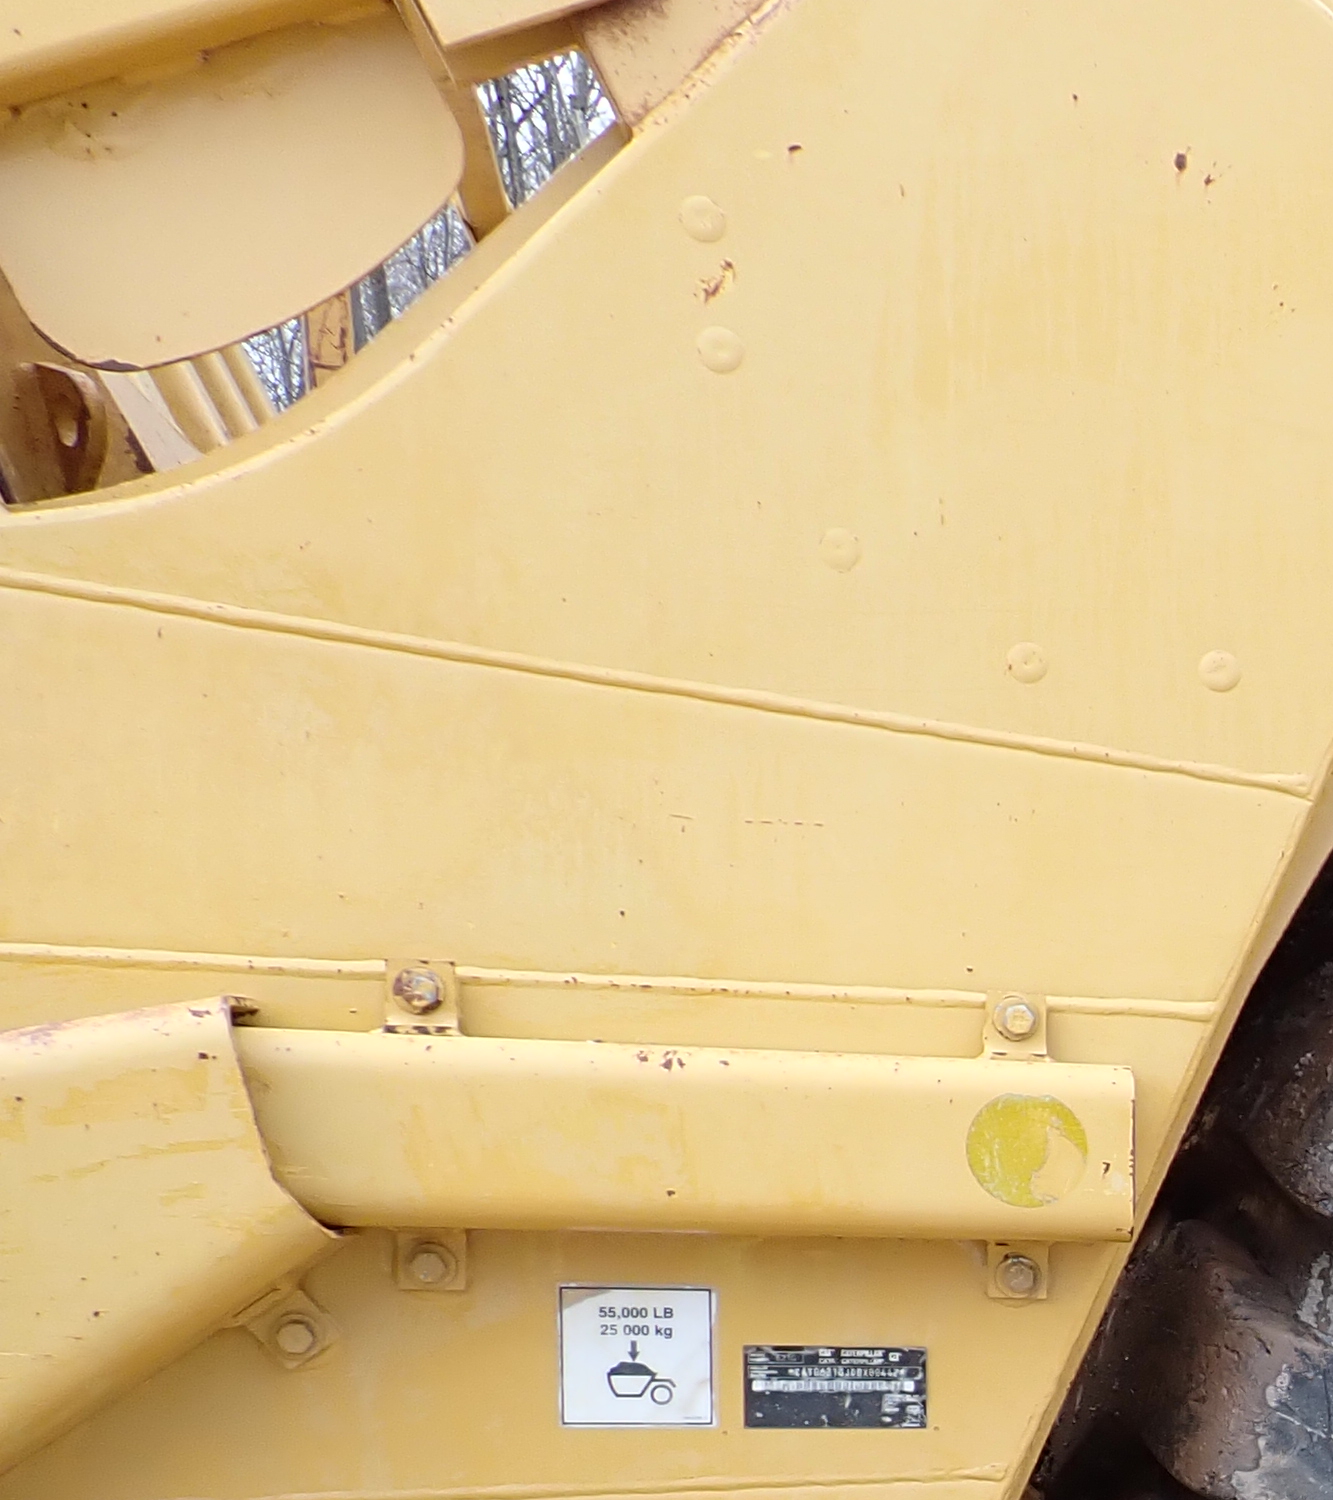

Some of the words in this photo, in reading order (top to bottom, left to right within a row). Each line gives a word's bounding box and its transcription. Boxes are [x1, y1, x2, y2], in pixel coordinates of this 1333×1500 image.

[599, 1307, 648, 1320] 55,000
[654, 1307, 674, 1319] LB
[600, 1325, 617, 1336] 25
[623, 1325, 649, 1336] 000
[655, 1325, 672, 1338] kg
